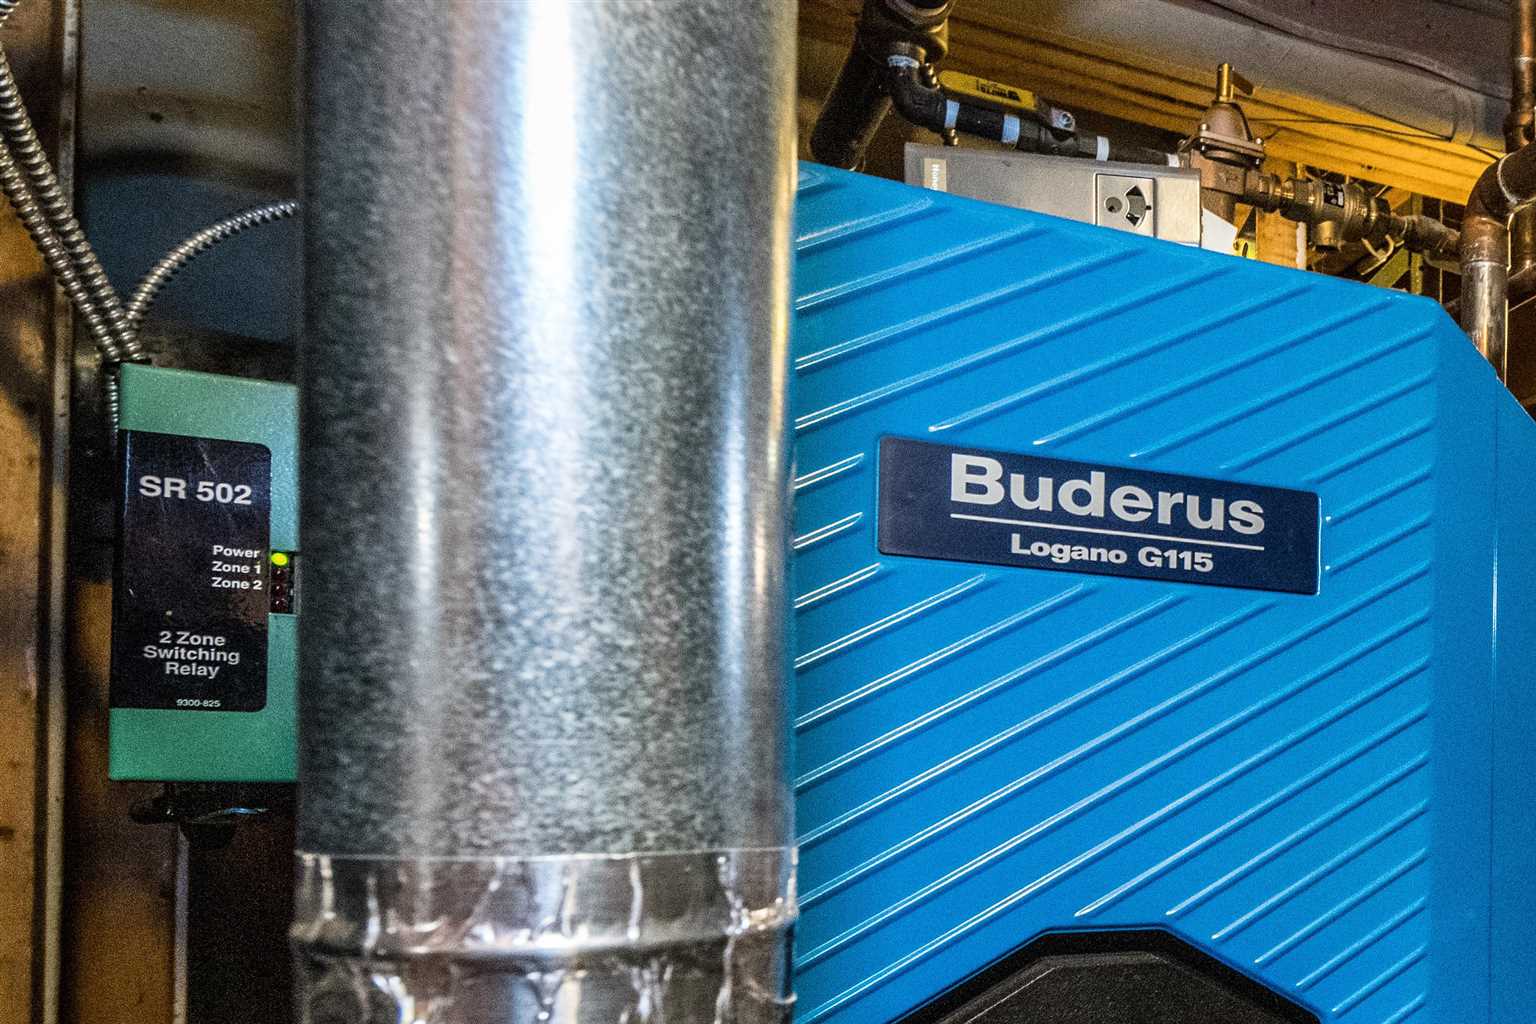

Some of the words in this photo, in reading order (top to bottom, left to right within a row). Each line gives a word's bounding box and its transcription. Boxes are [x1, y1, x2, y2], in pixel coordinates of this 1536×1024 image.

[139, 475, 187, 499] SR
[196, 481, 253, 505] 502
[951, 453, 1265, 535] Buderus
[212, 545, 261, 558] Power
[1011, 533, 1128, 564] Logano
[1138, 546, 1214, 572] G115
[211, 561, 250, 574] Zone
[254, 564, 262, 574] 1
[211, 577, 250, 589] Zone
[253, 579, 263, 590] 2
[159, 630, 172, 644] 2
[176, 631, 226, 646] Zone
[143, 645, 240, 665] Switching
[165, 661, 220, 679] Relay
